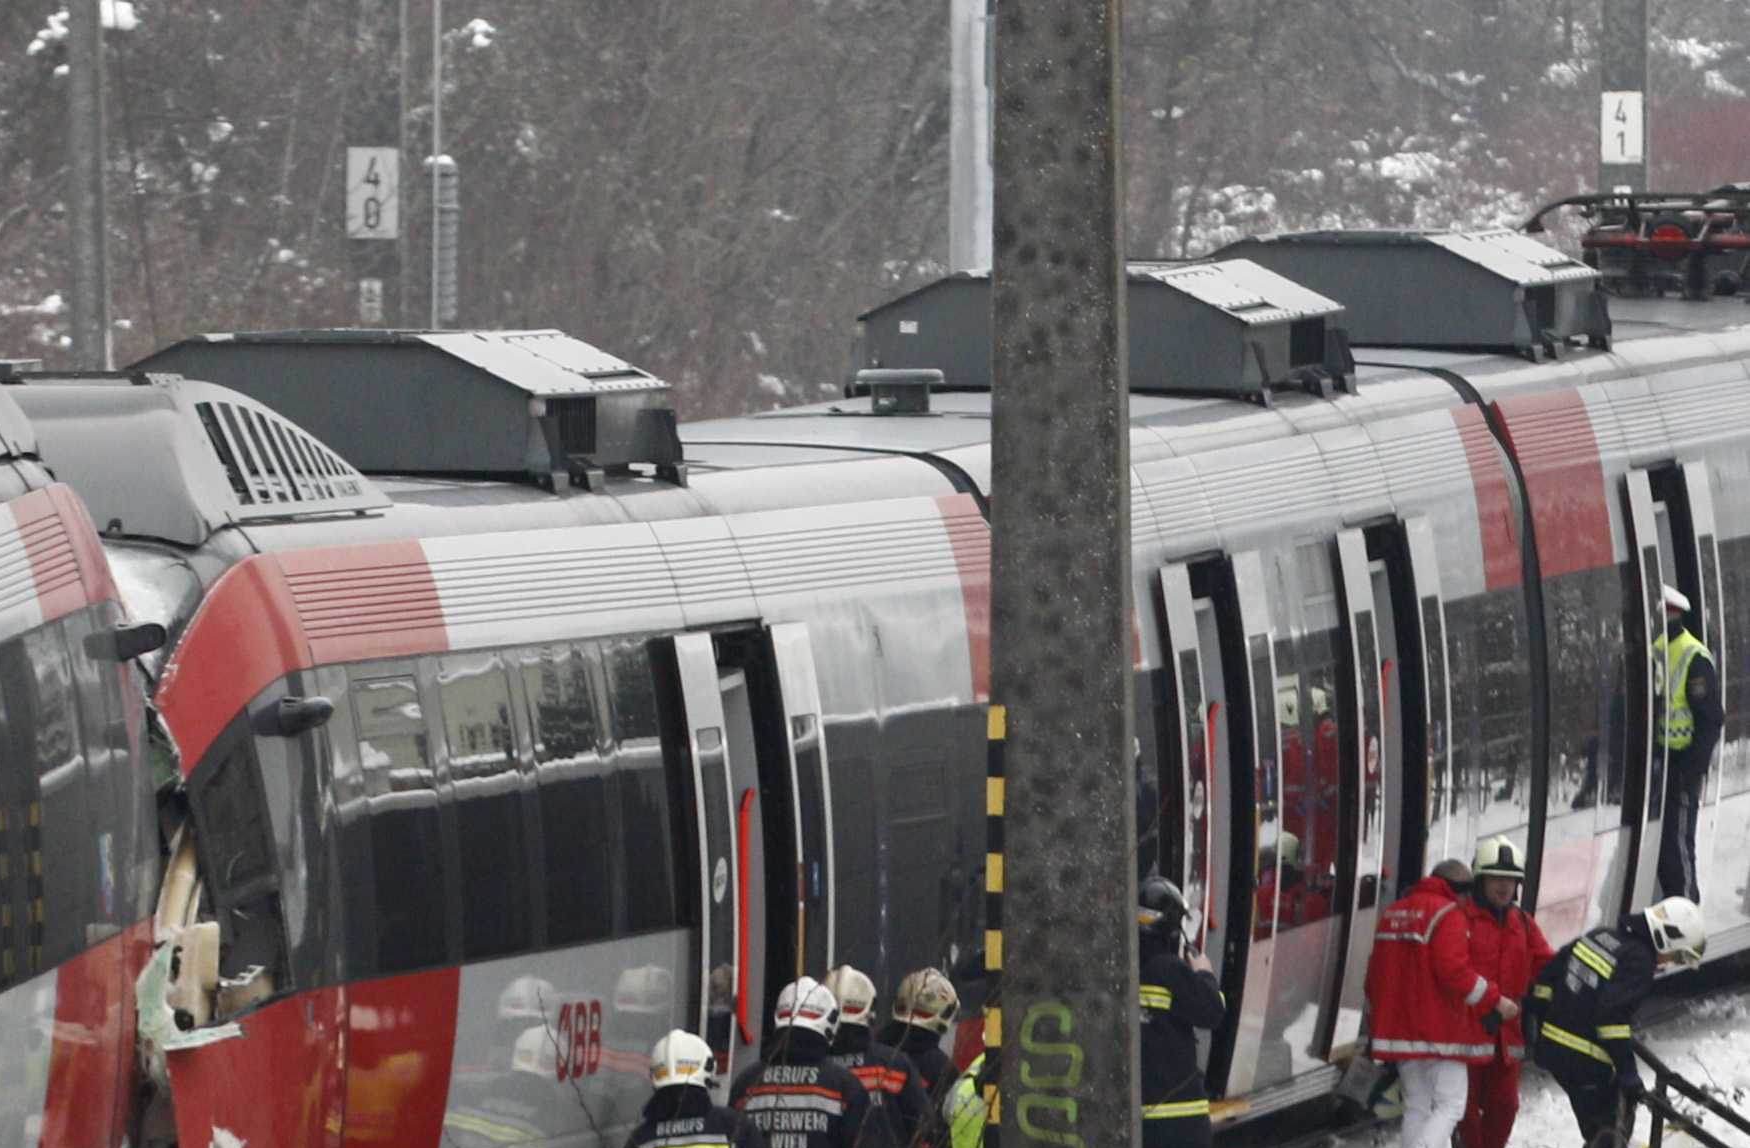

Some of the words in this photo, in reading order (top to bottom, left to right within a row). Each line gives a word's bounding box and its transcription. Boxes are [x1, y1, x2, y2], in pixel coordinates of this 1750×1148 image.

[1614, 98, 1627, 123] 4
[1617, 131, 1625, 157] 1
[363, 156, 380, 188] 4
[364, 197, 381, 229] 0
[763, 1065, 819, 1084] BERUFS
